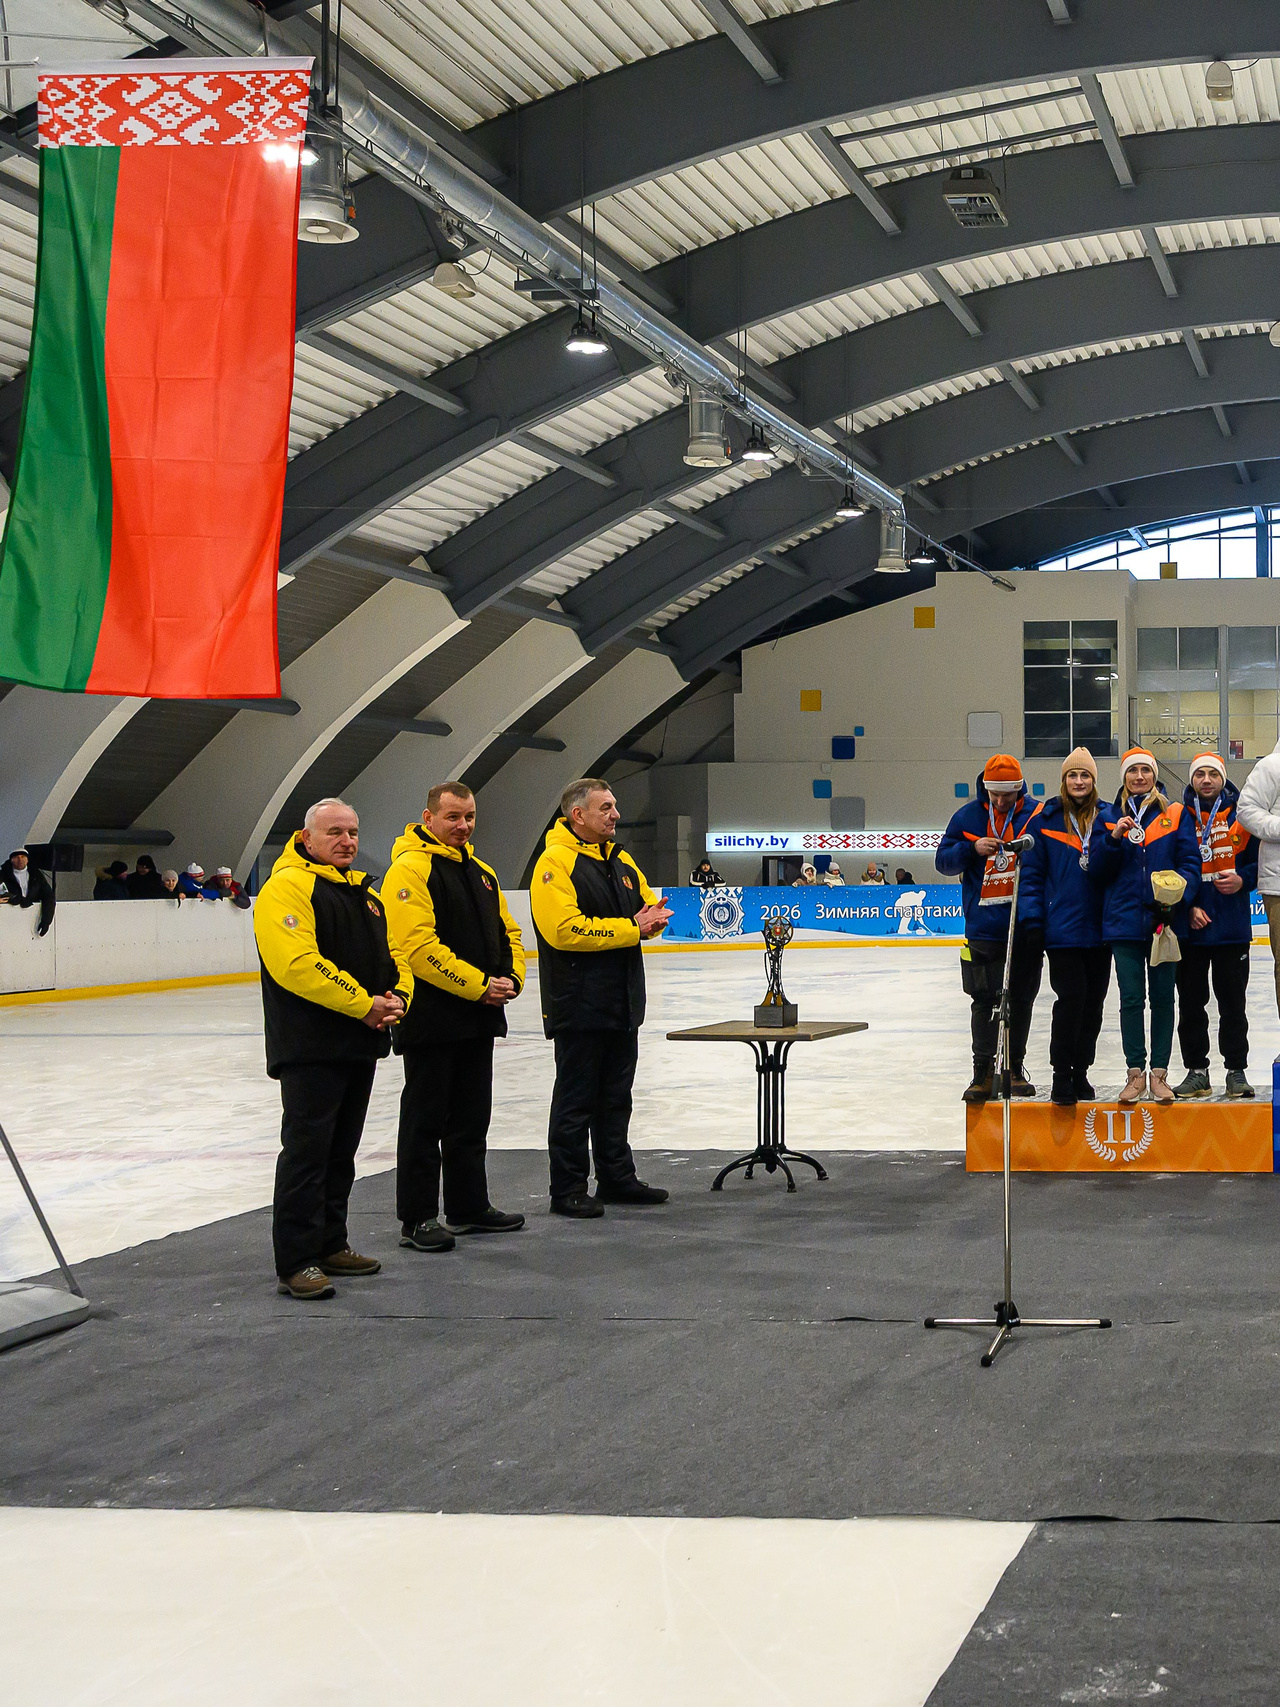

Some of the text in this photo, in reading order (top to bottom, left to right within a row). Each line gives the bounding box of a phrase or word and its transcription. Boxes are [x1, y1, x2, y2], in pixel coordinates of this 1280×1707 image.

[714, 835, 789, 848] silichy.by
[760, 904, 801, 920] 2026
[815, 903, 964, 921] Зимняя спартаки
[570, 925, 615, 938] BELARUS
[314, 961, 357, 996] BELARUS
[426, 954, 468, 987] BELARUS
[1102, 1110, 1136, 1144] II
